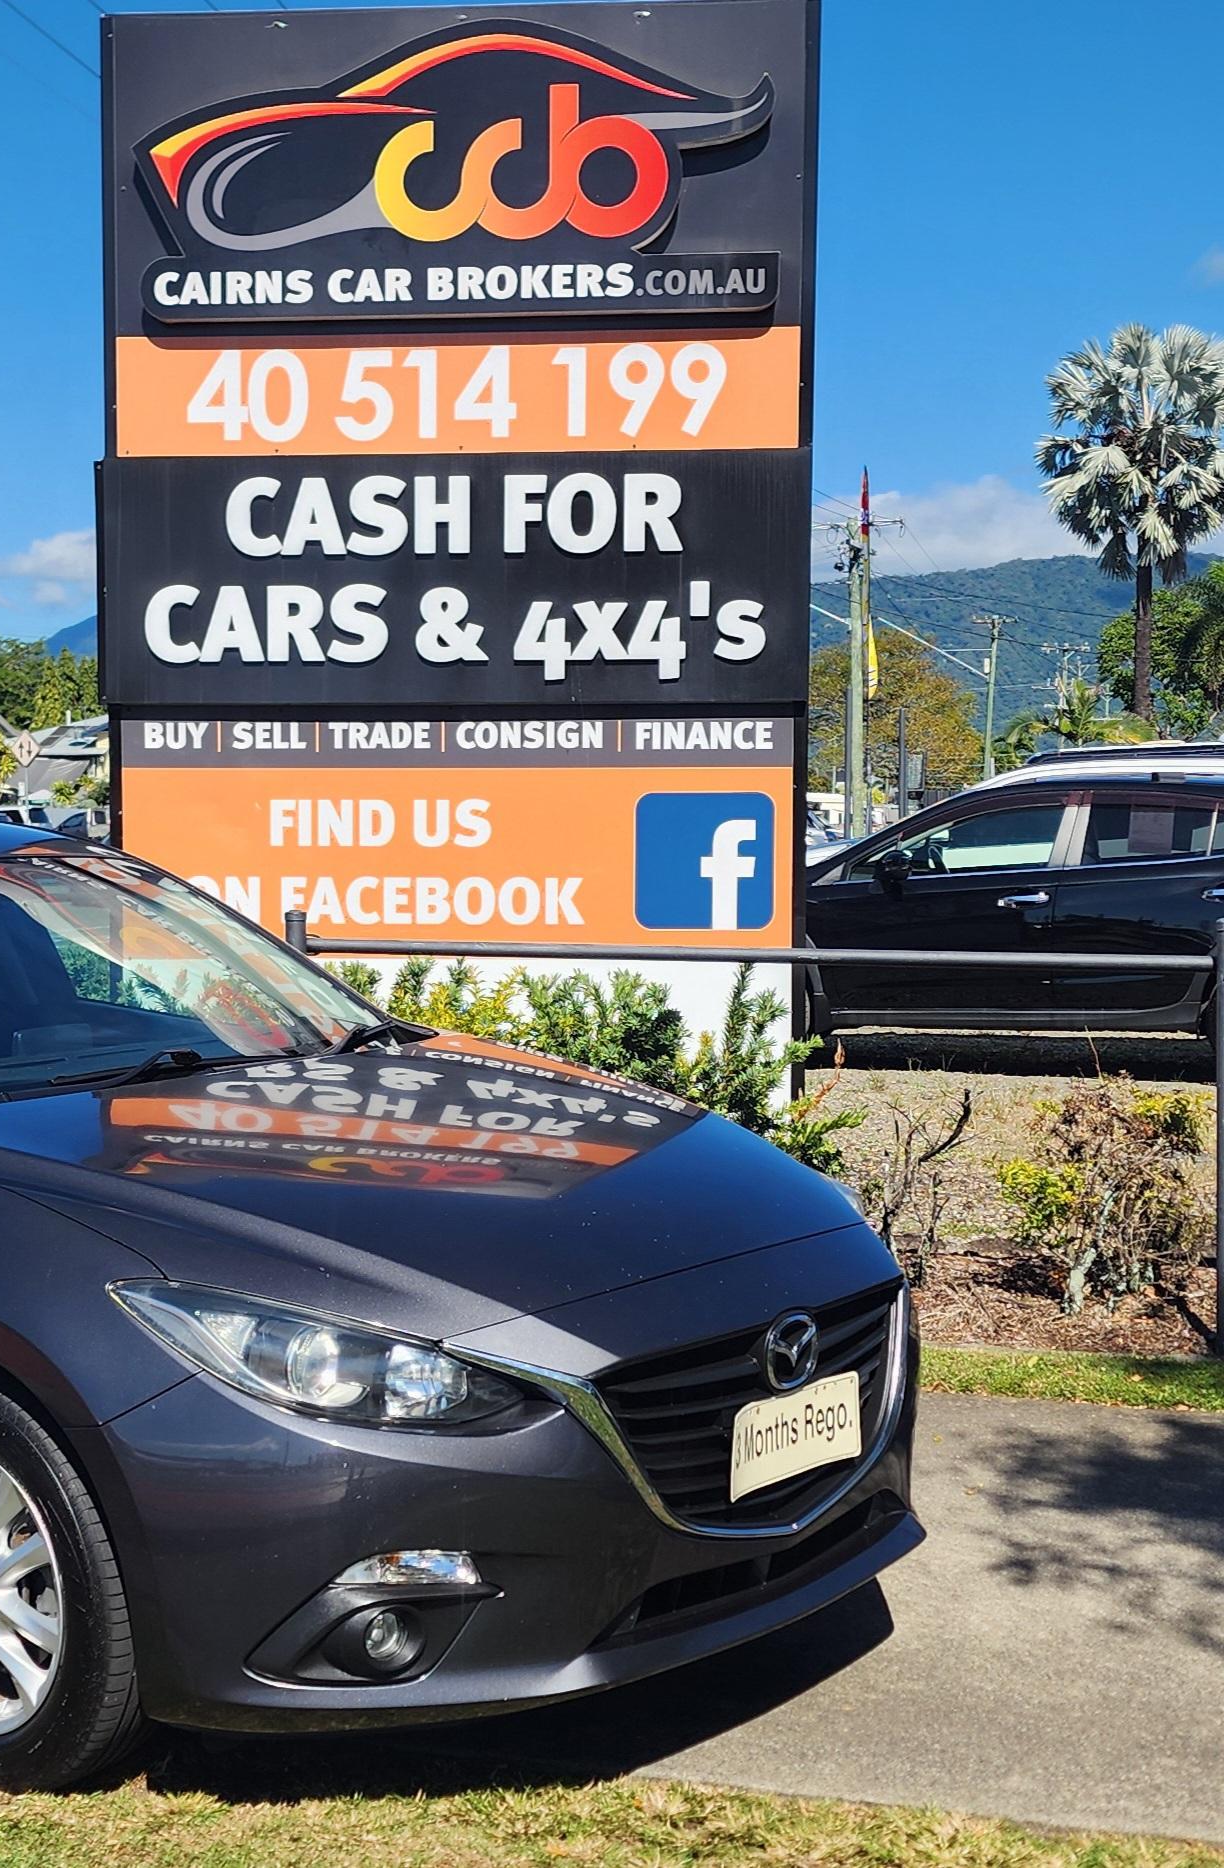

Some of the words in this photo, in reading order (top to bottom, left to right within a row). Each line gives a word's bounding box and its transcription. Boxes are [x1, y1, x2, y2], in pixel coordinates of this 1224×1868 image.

[153, 269, 315, 307] CAIRNS
[332, 267, 413, 303] CAR
[187, 349, 309, 443] 40
[334, 345, 518, 440] 514
[551, 342, 728, 438] 199
[225, 475, 471, 557] CASH
[504, 472, 684, 554] FOR
[143, 584, 389, 665] CARS
[414, 586, 489, 664] &
[143, 721, 210, 750] BUY
[231, 721, 307, 750] SELL
[328, 721, 431, 750] TRADE
[455, 721, 604, 750] CONSIGN
[635, 721, 774, 750] FINANCE
[269, 799, 396, 848] FIND
[412, 798, 493, 848] US
[280, 875, 585, 927] FACEBOOK
[735, 1433, 743, 1469] 3
[744, 1412, 799, 1464] Months
[804, 1401, 854, 1443] Rego.
